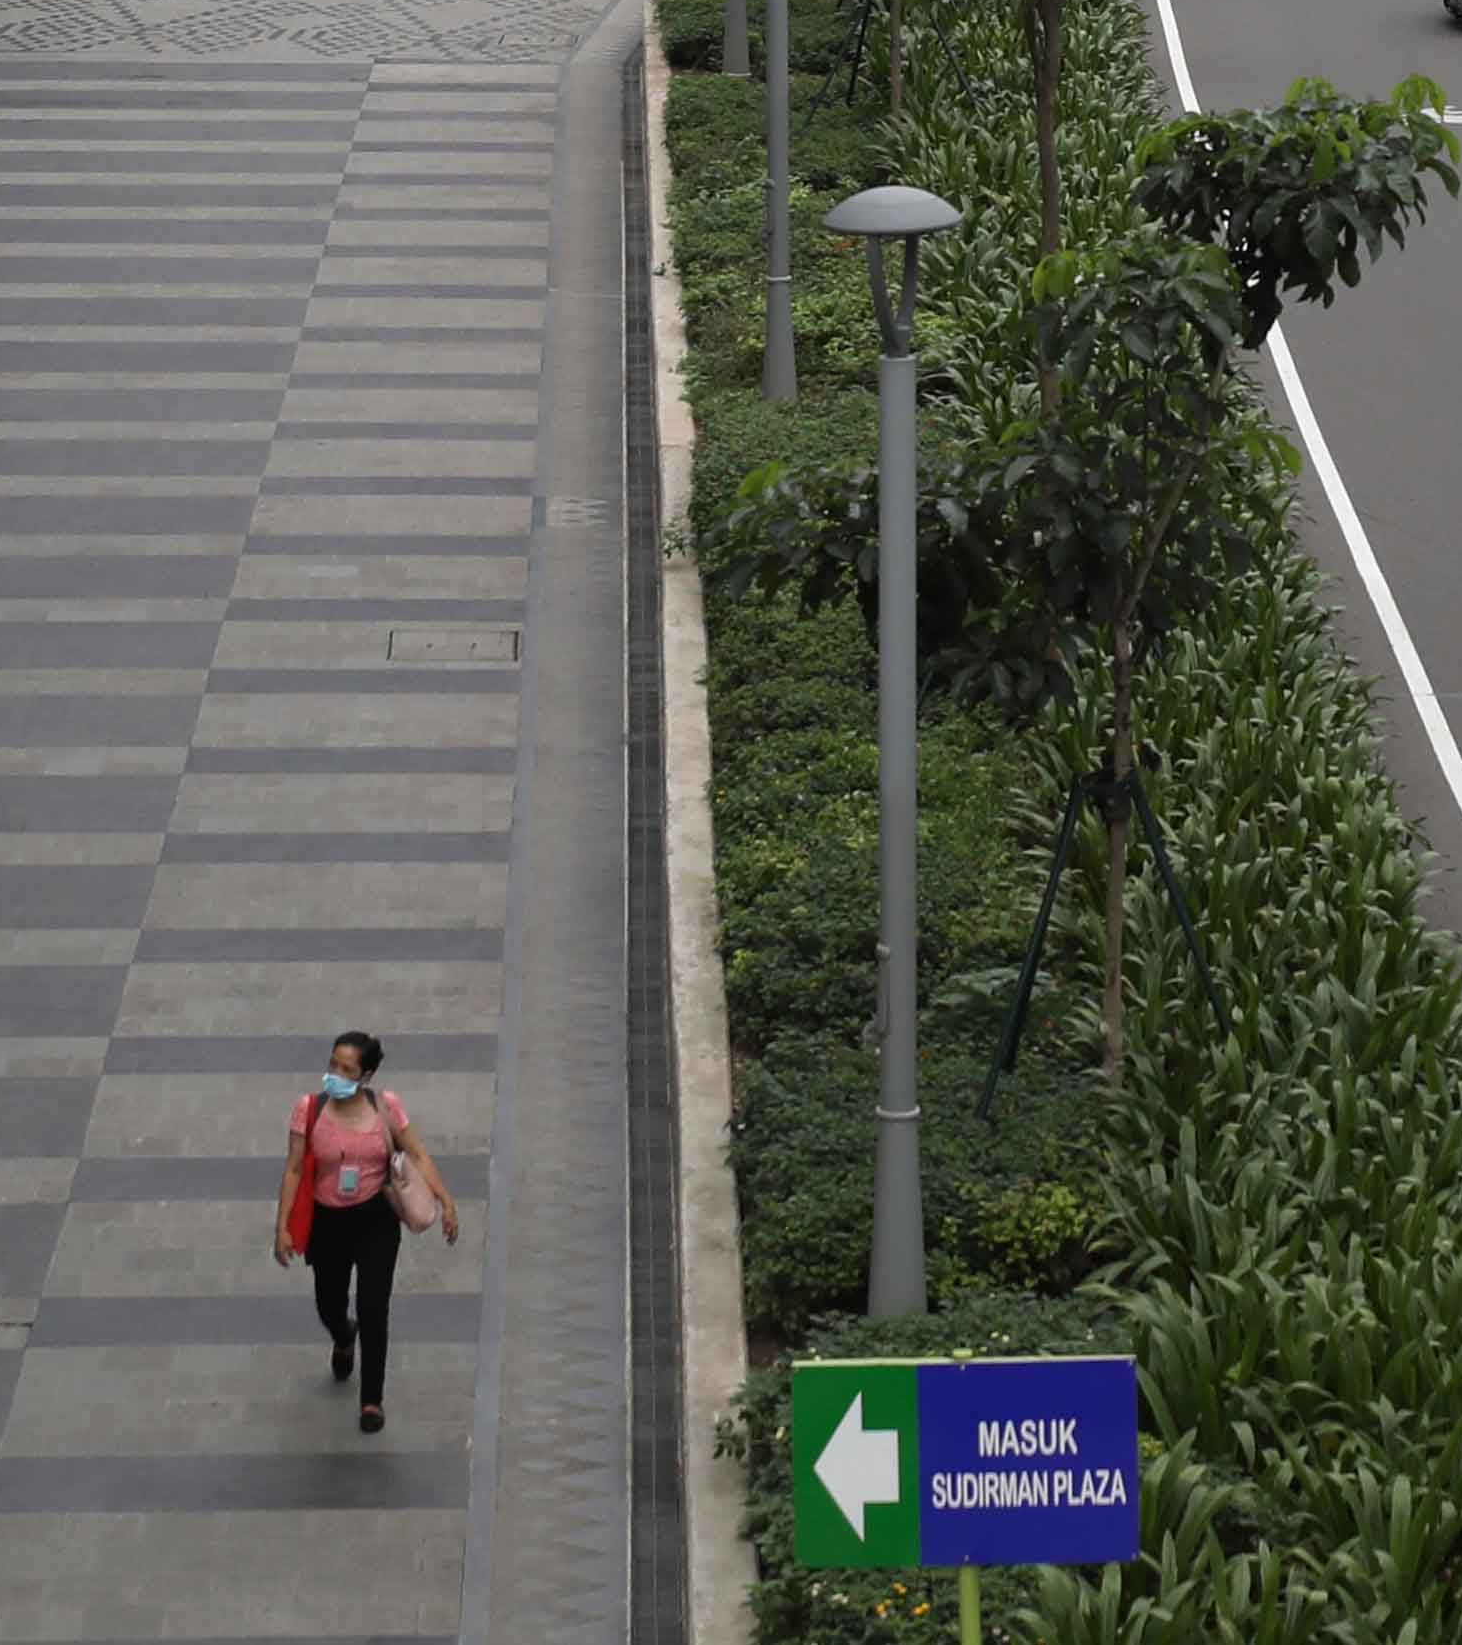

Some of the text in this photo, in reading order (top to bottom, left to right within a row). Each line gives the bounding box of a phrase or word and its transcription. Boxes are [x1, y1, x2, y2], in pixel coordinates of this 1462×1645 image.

[978, 1418, 1078, 1457] MASUK
[932, 1468, 1127, 1509] SUDIRMAN PLAZA
